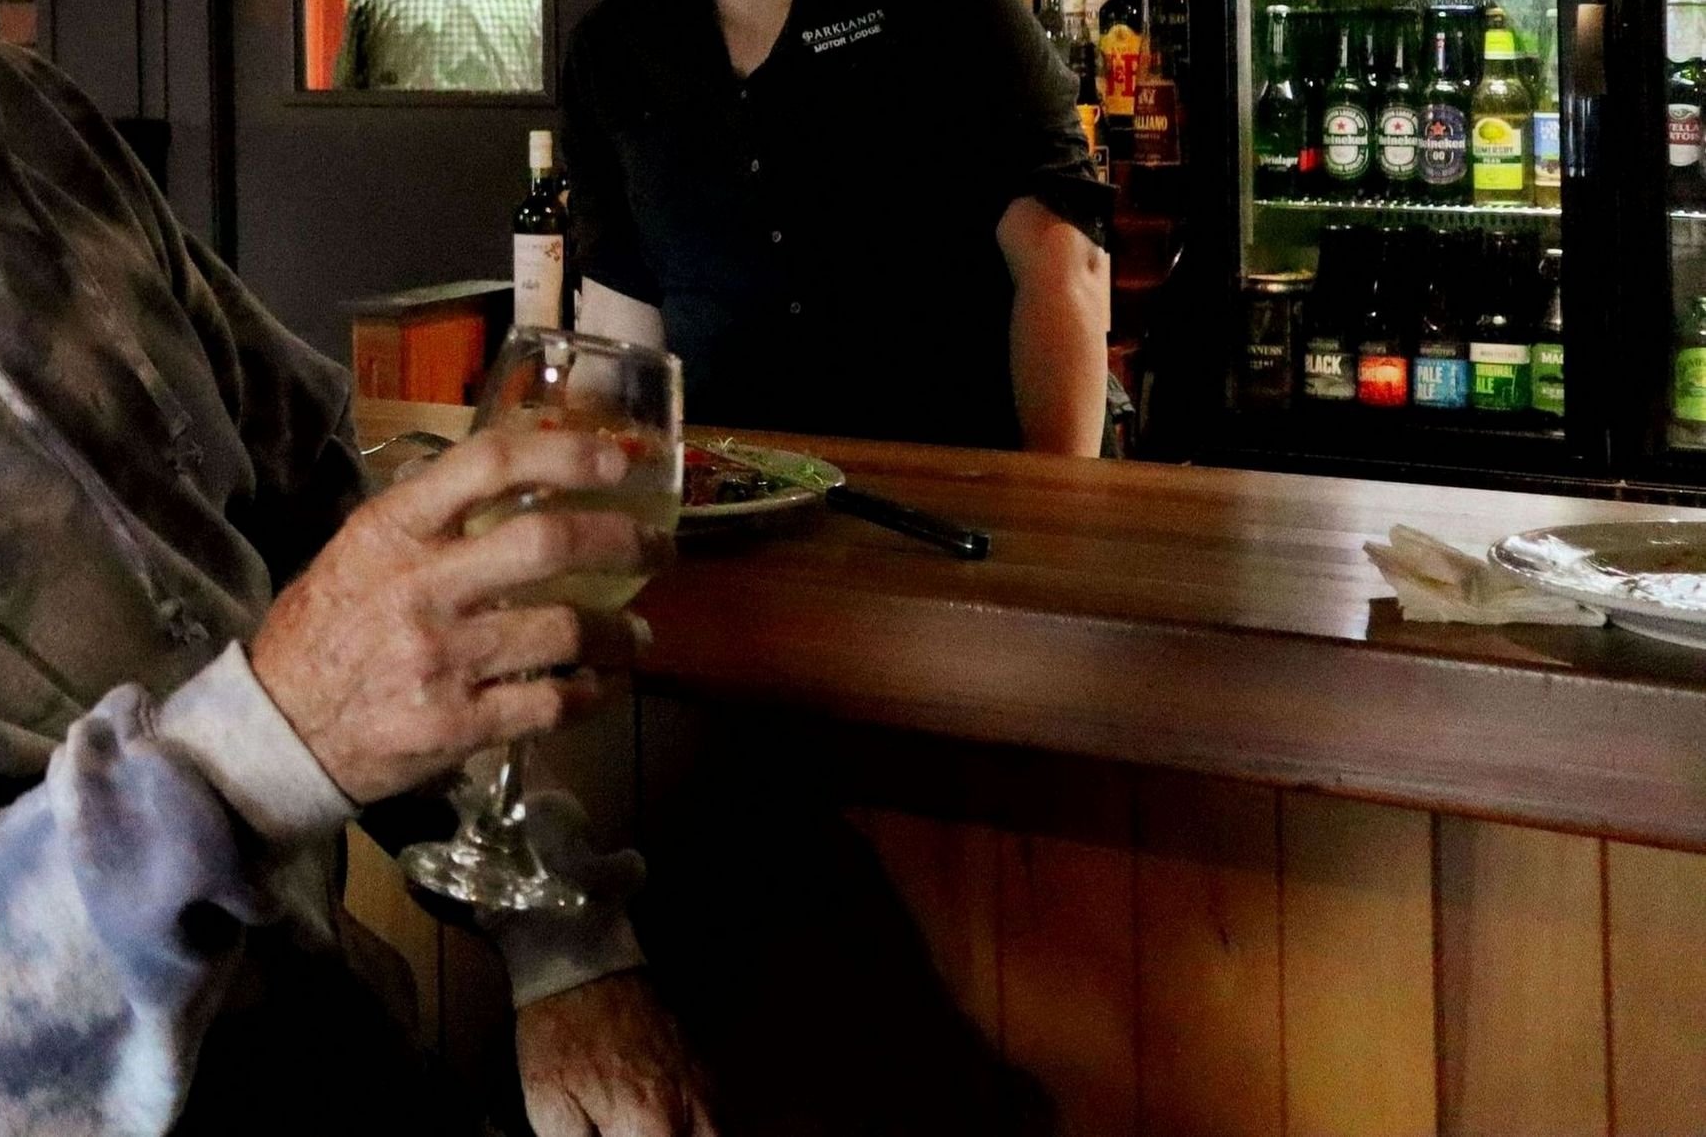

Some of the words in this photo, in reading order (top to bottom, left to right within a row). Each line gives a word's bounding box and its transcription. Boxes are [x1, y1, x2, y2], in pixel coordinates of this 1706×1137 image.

[802, 9, 885, 42] PARKLANDS
[814, 36, 846, 53] MOTOR
[849, 24, 882, 42] LODGE
